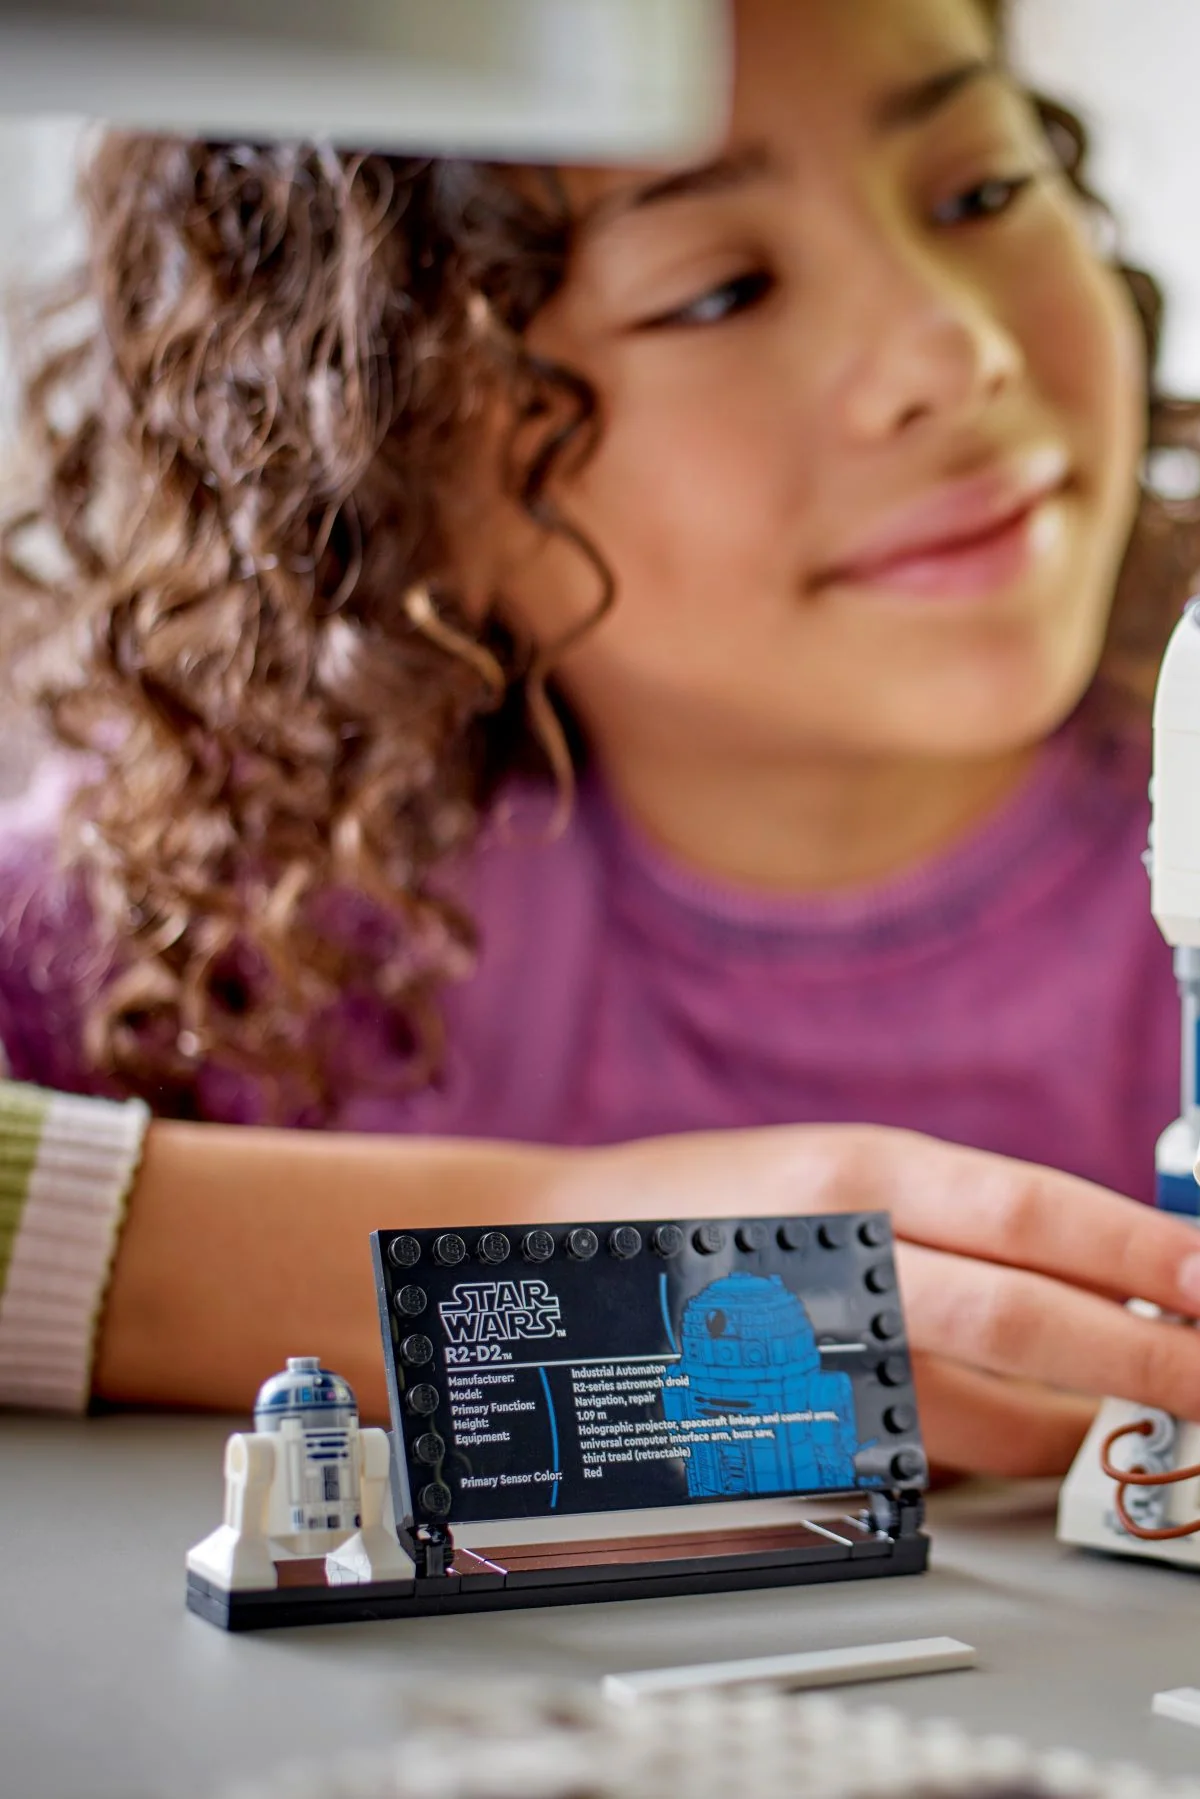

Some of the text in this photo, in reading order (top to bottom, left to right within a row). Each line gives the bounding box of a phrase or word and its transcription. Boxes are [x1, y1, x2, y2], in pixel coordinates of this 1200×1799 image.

[439, 1280, 560, 1313] STAR
[571, 1365, 667, 1379] Industrial Automaton
[448, 1374, 515, 1387] Manufacturer:
[573, 1376, 690, 1393] R2-series astromech droid
[450, 1389, 483, 1401] Model:
[574, 1392, 656, 1408] Navigation, repair
[452, 1400, 536, 1415] Primary Function:
[576, 1411, 607, 1421] 1.09 m
[453, 1418, 490, 1430] Height:
[578, 1421, 634, 1436] Holographic
[635, 1420, 679, 1434] projector,
[455, 1431, 511, 1446] Equipment:
[580, 1436, 623, 1449] universal
[624, 1435, 668, 1448] computer
[669, 1431, 710, 1444] interface
[582, 1446, 691, 1464] third tread (retractable)
[461, 1470, 563, 1488] Primary Sensor Color:
[584, 1466, 603, 1478] Red
